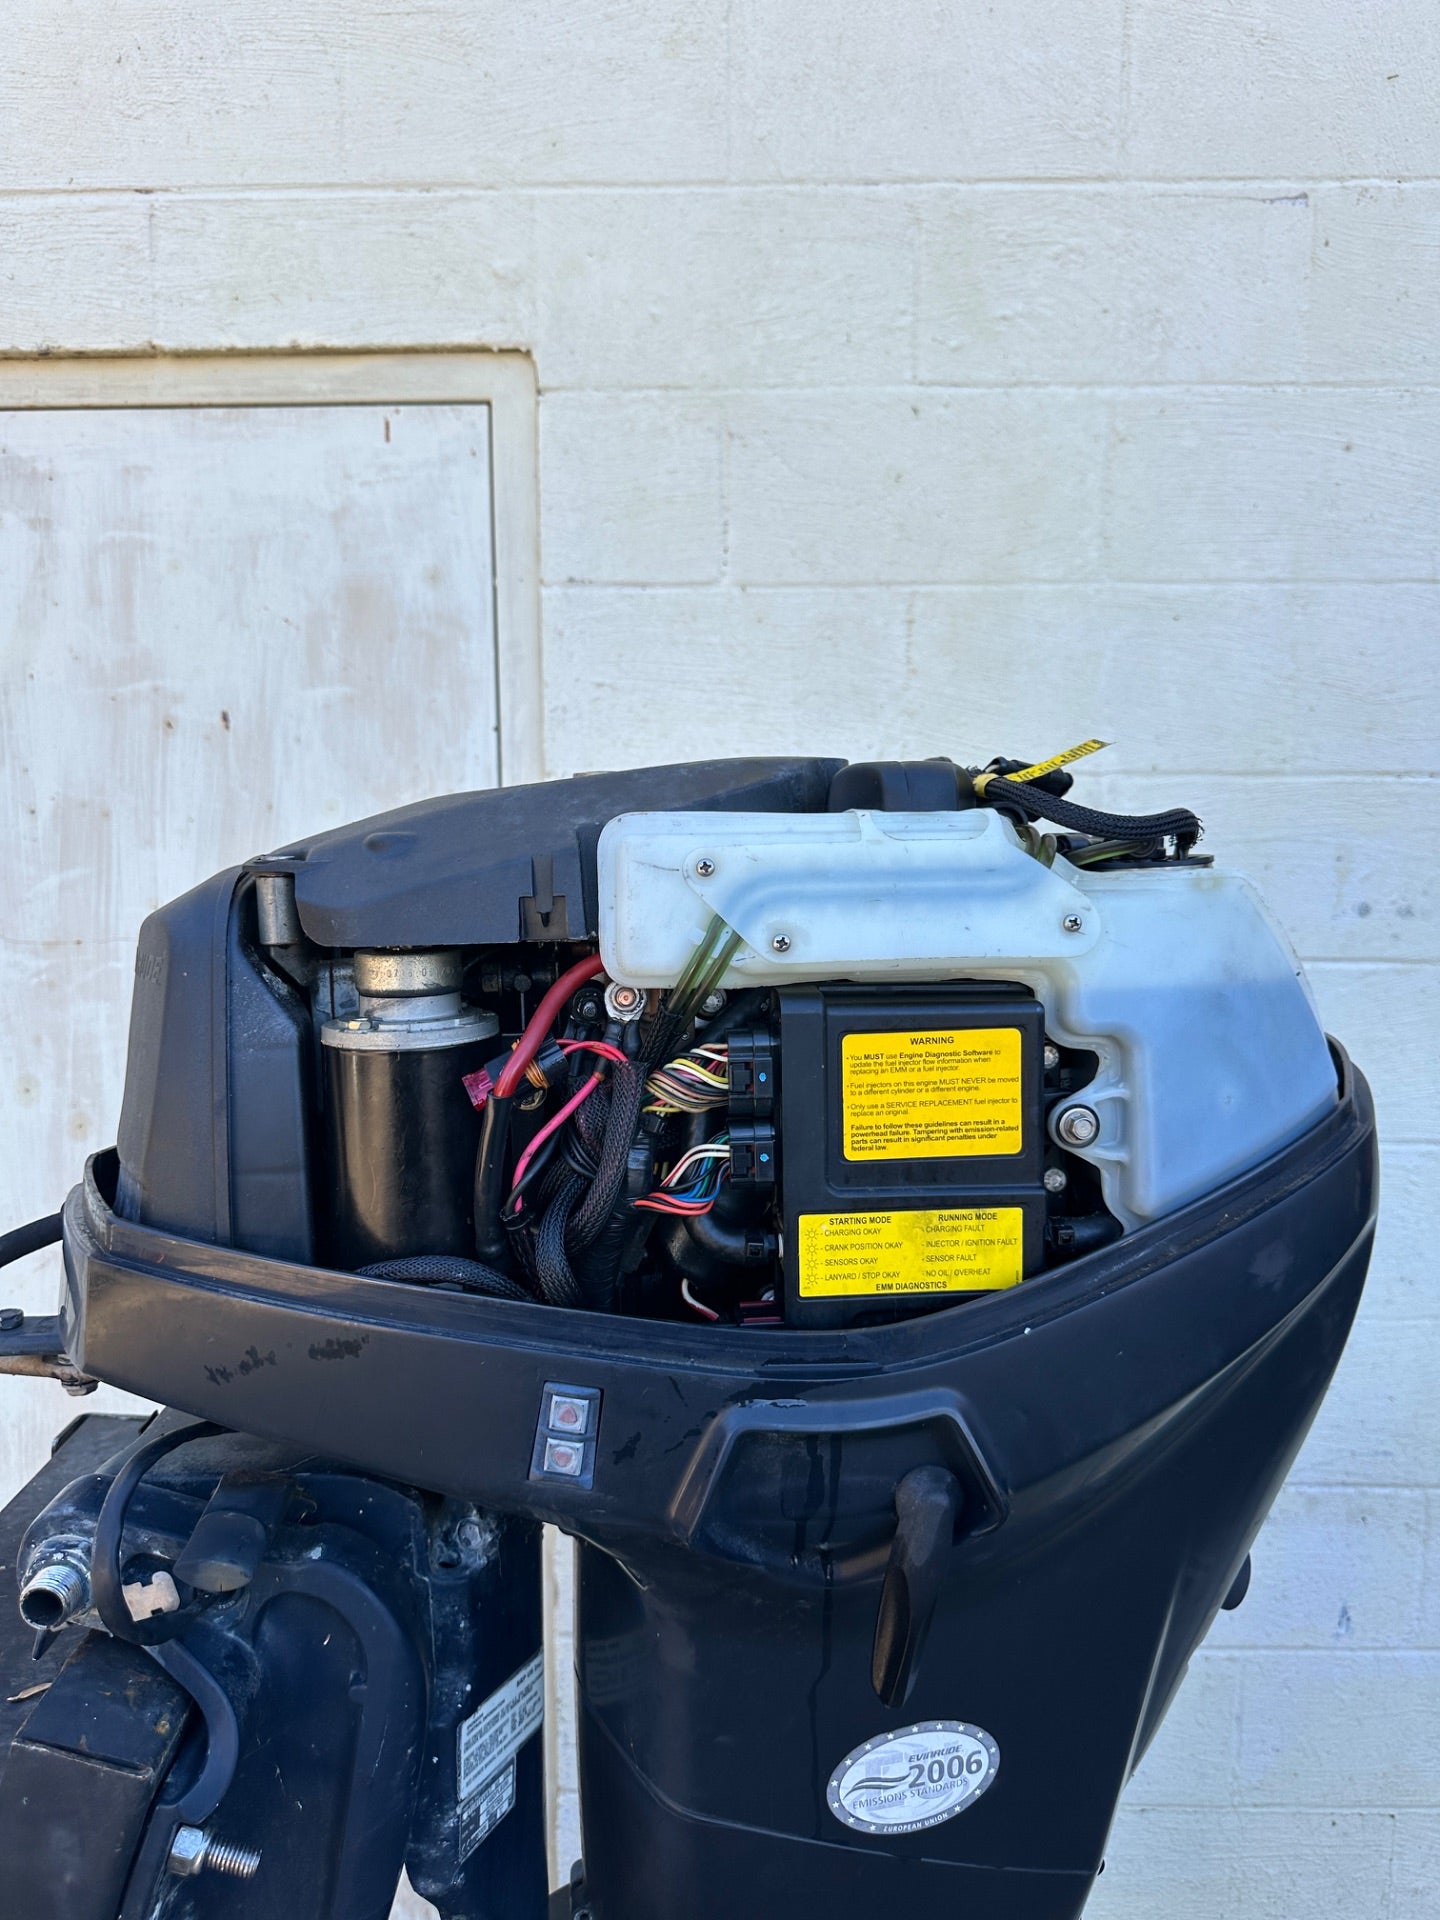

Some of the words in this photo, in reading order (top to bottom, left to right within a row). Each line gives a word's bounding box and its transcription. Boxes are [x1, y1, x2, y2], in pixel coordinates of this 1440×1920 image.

[910, 1036, 954, 1045] WARNING
[900, 1052, 924, 1060] Engine
[925, 1050, 962, 1059] Diagnostic
[850, 1060, 872, 1068] update
[898, 1059, 920, 1067] injector
[919, 1098, 972, 1107] REPLACEMENT
[850, 1110, 874, 1118] replace
[924, 1121, 958, 1129] guidelines
[913, 1128, 948, 1136] Tampering
[965, 1124, 1019, 1132] emission-related
[911, 1134, 946, 1143] significant
[947, 1133, 976, 1142] penalties
[829, 1216, 867, 1225] STARTING
[869, 1216, 892, 1224] MODE
[938, 1213, 973, 1221] RUNNING
[975, 1212, 998, 1220] MODE
[825, 1228, 862, 1237] CHARGING
[926, 1225, 963, 1233] CHARGING
[825, 1244, 849, 1252] CRANK
[850, 1242, 883, 1251] POSITION
[926, 1240, 960, 1248] INJECTOR
[965, 1239, 996, 1247] IGNITION
[825, 1258, 858, 1266] SENSORS
[860, 1257, 878, 1265] OKAY
[825, 1273, 857, 1281] LANYARD
[862, 1272, 880, 1280] STOP
[882, 1271, 901, 1279] OKAY
[938, 1269, 949, 1277] OIL
[954, 1268, 991, 1276] OVERHEAT
[876, 1283, 894, 1292] EMM
[895, 1281, 948, 1291] DIAGNOSTICS
[908, 1745, 962, 1762] EVINRUDE
[908, 1750, 983, 1788] 2006
[853, 1792, 908, 1810] EMISSIONS
[910, 1778, 969, 1798] STANDARDS
[883, 1822, 922, 1833] EUROPEAN
[925, 1813, 948, 1826] UNION
